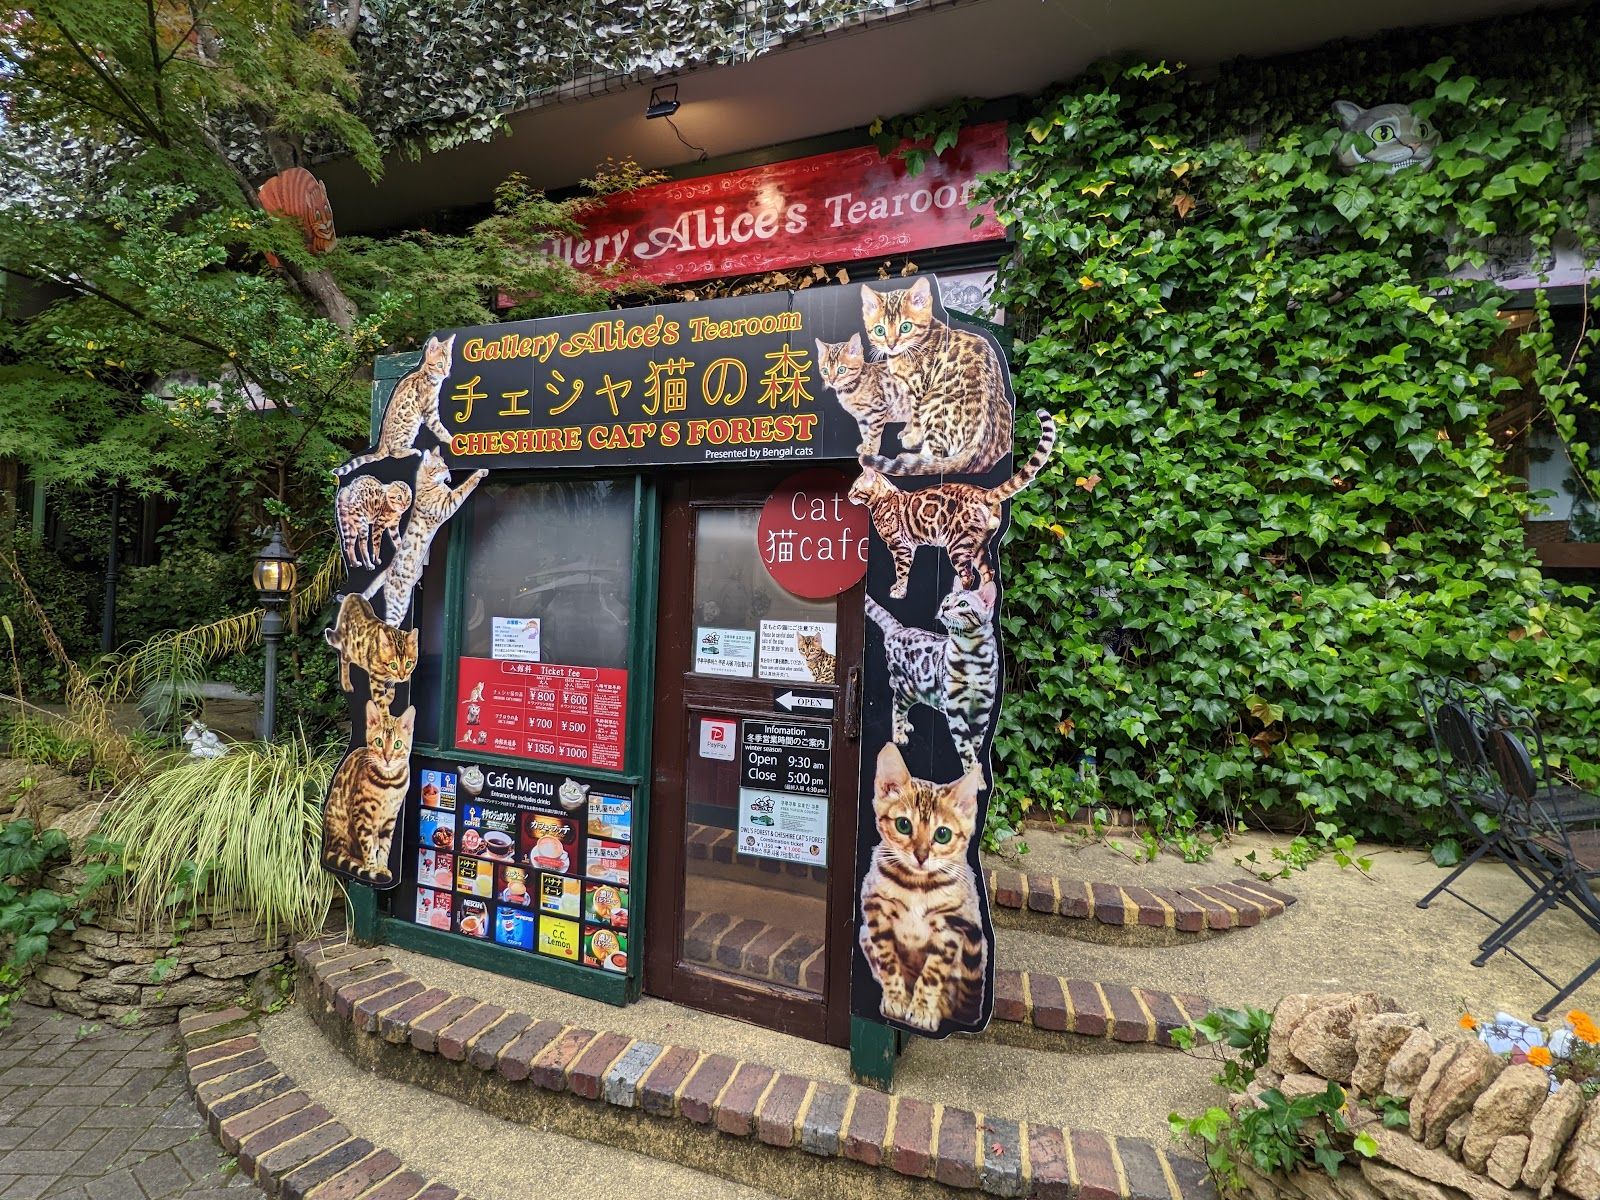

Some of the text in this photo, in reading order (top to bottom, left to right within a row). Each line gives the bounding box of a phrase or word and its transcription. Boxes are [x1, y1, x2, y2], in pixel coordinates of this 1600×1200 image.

[634, 196, 808, 260] Alice's
[463, 311, 803, 363] Gallery Alice's Tearoom
[450, 344, 815, 422] チェシャ猫の森
[450, 427, 583, 456] CHESHIRE
[686, 414, 818, 445] FOREST
[705, 446, 813, 460] Presented by Bengal cats
[791, 491, 843, 522] Cat
[540, 666, 564, 677] Ticket
[568, 667, 580, 678] fee
[529, 690, 556, 703] ¥800
[562, 693, 588, 706] ¥600
[797, 695, 823, 707] OPEN
[528, 717, 553, 729] ¥700
[561, 720, 587, 733] ¥500
[764, 725, 806, 736] Infomation
[707, 741, 728, 749] PayPay
[746, 733, 825, 748] 冬季営業時間のご案内
[558, 745, 588, 759] ¥1000
[748, 752, 778, 766] Open
[788, 755, 811, 769] 9:30
[812, 762, 824, 770] am
[486, 771, 554, 796] Cafe Menu
[748, 768, 824, 786] Close 5:00 pm
[490, 790, 510, 800] Entrance
[518, 794, 537, 804] includes
[537, 797, 551, 806] drinks
[464, 820, 480, 828] COFFEE
[790, 840, 804, 848] ticket
[460, 859, 477, 868] バナナ
[460, 869, 476, 878] オーレ
[544, 877, 562, 887] バナナ
[544, 886, 562, 896] オーレ
[552, 929, 568, 941] C.C.
[547, 936, 571, 949] Lemon
